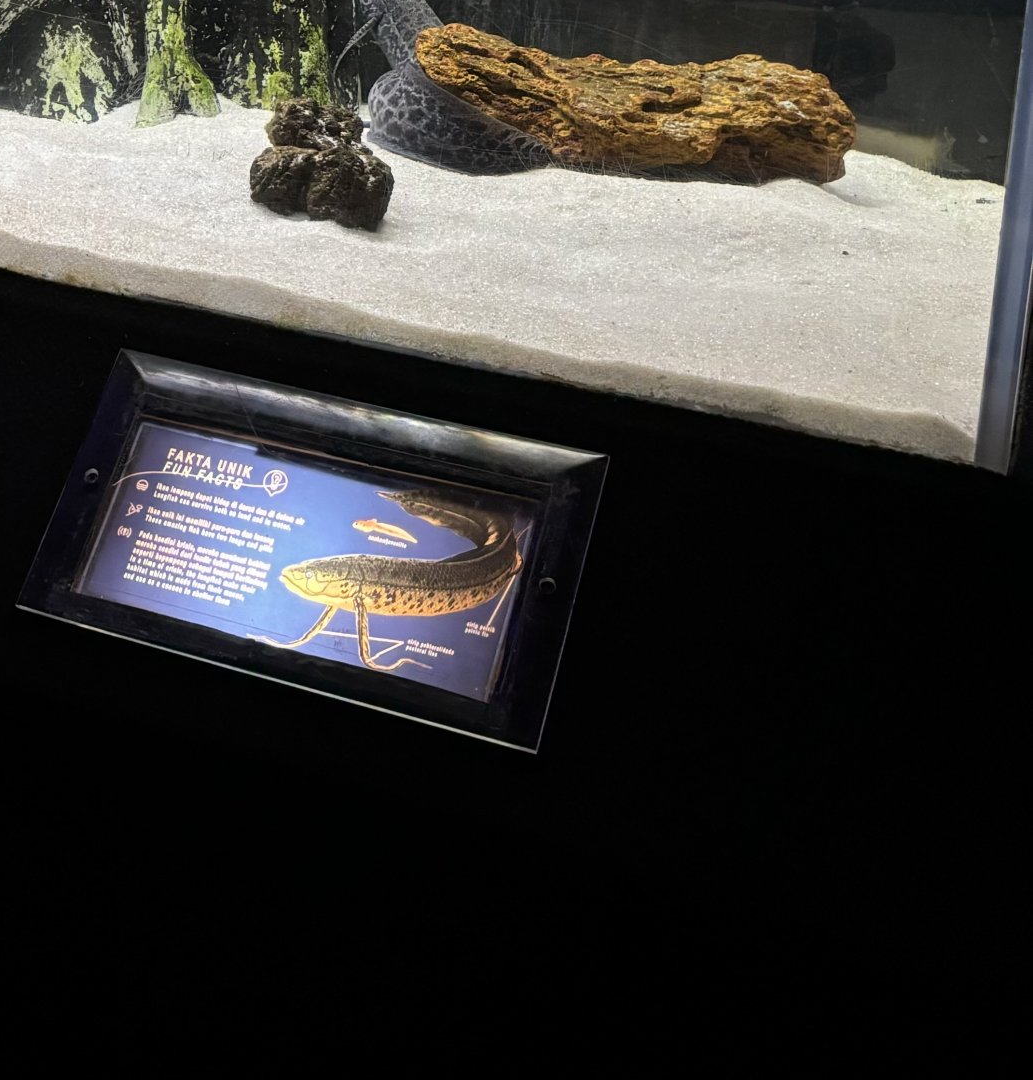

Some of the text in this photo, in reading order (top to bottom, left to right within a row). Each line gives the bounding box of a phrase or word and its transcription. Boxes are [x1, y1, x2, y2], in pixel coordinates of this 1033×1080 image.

[162, 462, 192, 477] FUN
[167, 448, 253, 479] FAKTA UNIK
